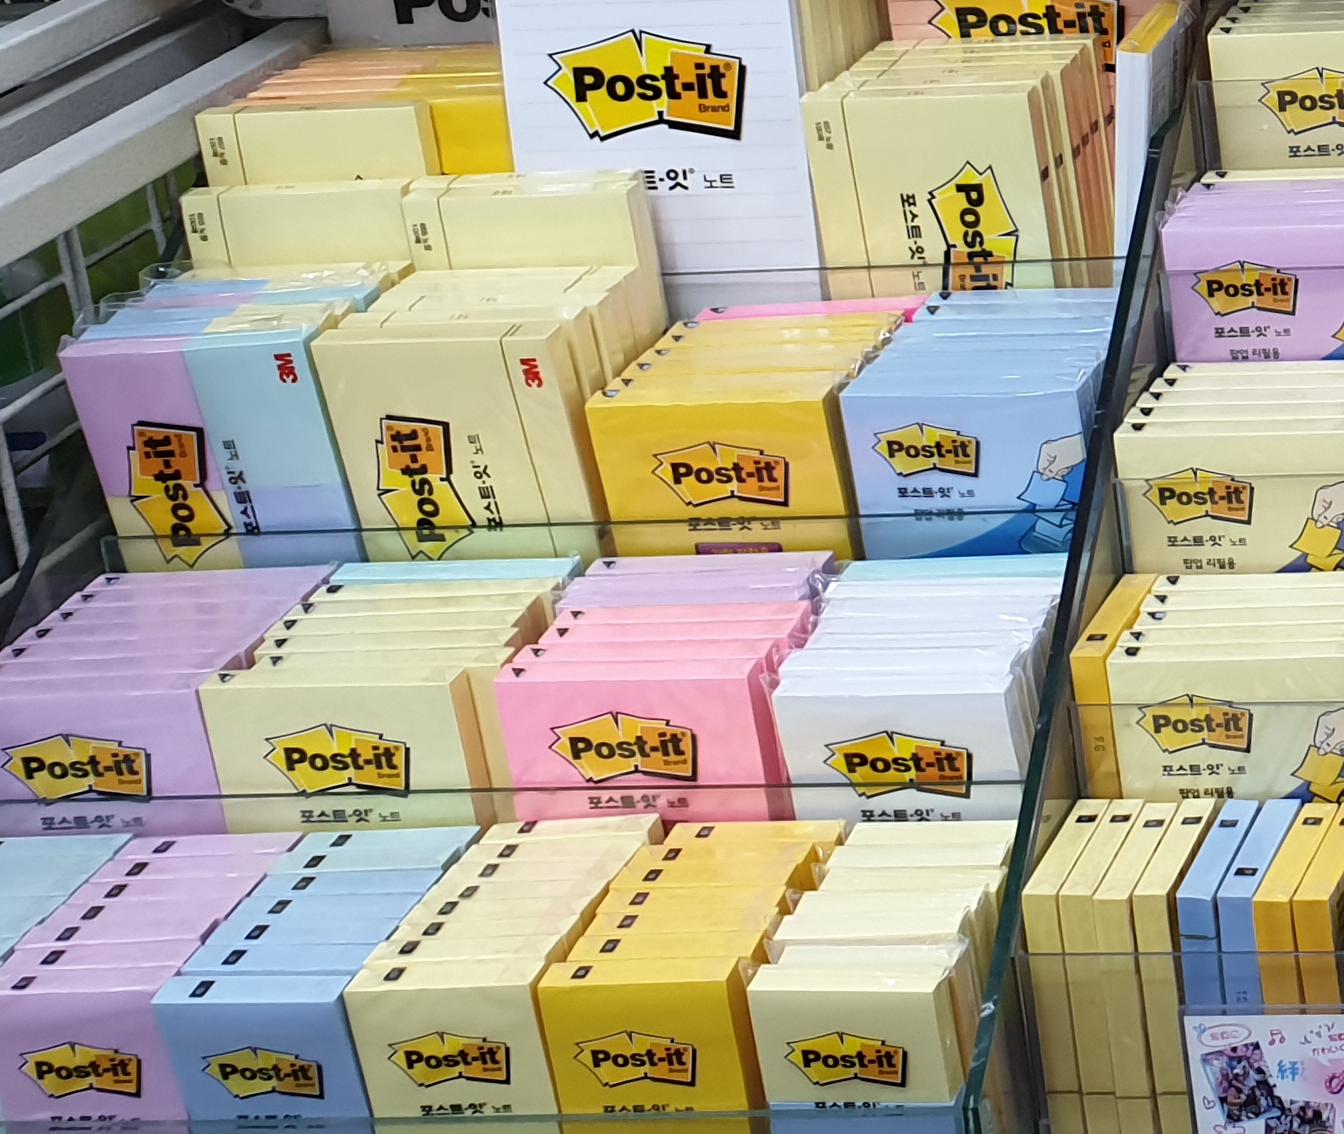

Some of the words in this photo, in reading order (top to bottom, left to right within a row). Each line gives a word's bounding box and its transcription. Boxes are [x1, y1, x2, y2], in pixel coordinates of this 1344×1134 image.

[575, 64, 727, 102] Post-it
[887, 440, 970, 460] Post-it
[671, 461, 778, 485] Post-it
[284, 746, 398, 771] Post-it
[569, 735, 687, 761] Post-it
[22, 751, 139, 780] Post-it
